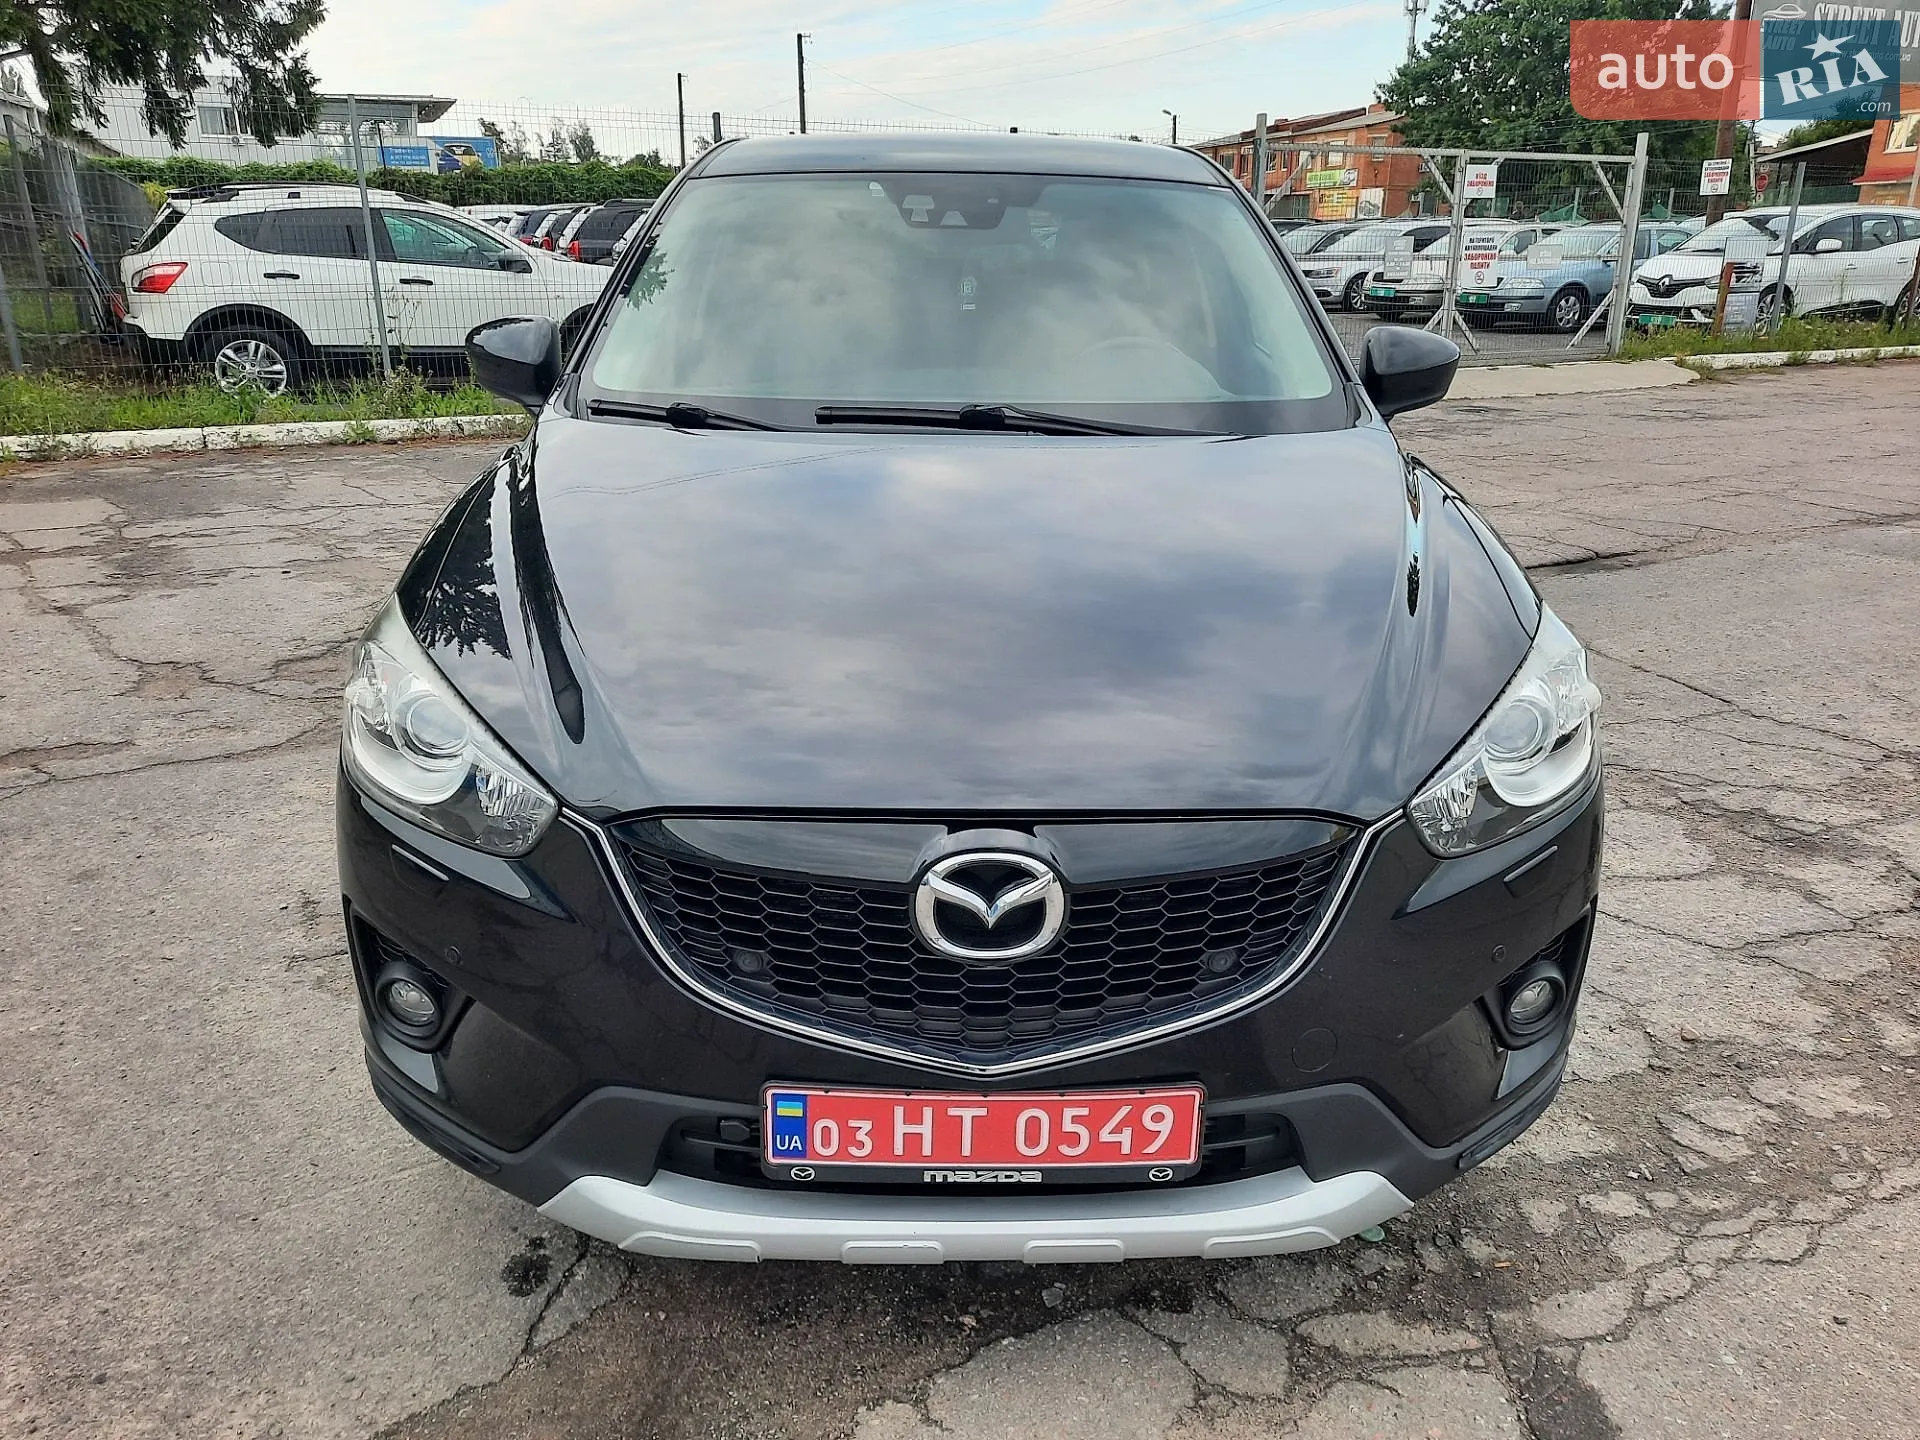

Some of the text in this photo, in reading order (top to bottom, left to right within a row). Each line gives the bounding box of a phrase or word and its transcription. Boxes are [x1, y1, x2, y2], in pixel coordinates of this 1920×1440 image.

[1764, 35, 1796, 51] AUTO
[1811, 2, 1885, 46] STREET
[776, 1104, 1175, 1157] UA 03 HT 0549
